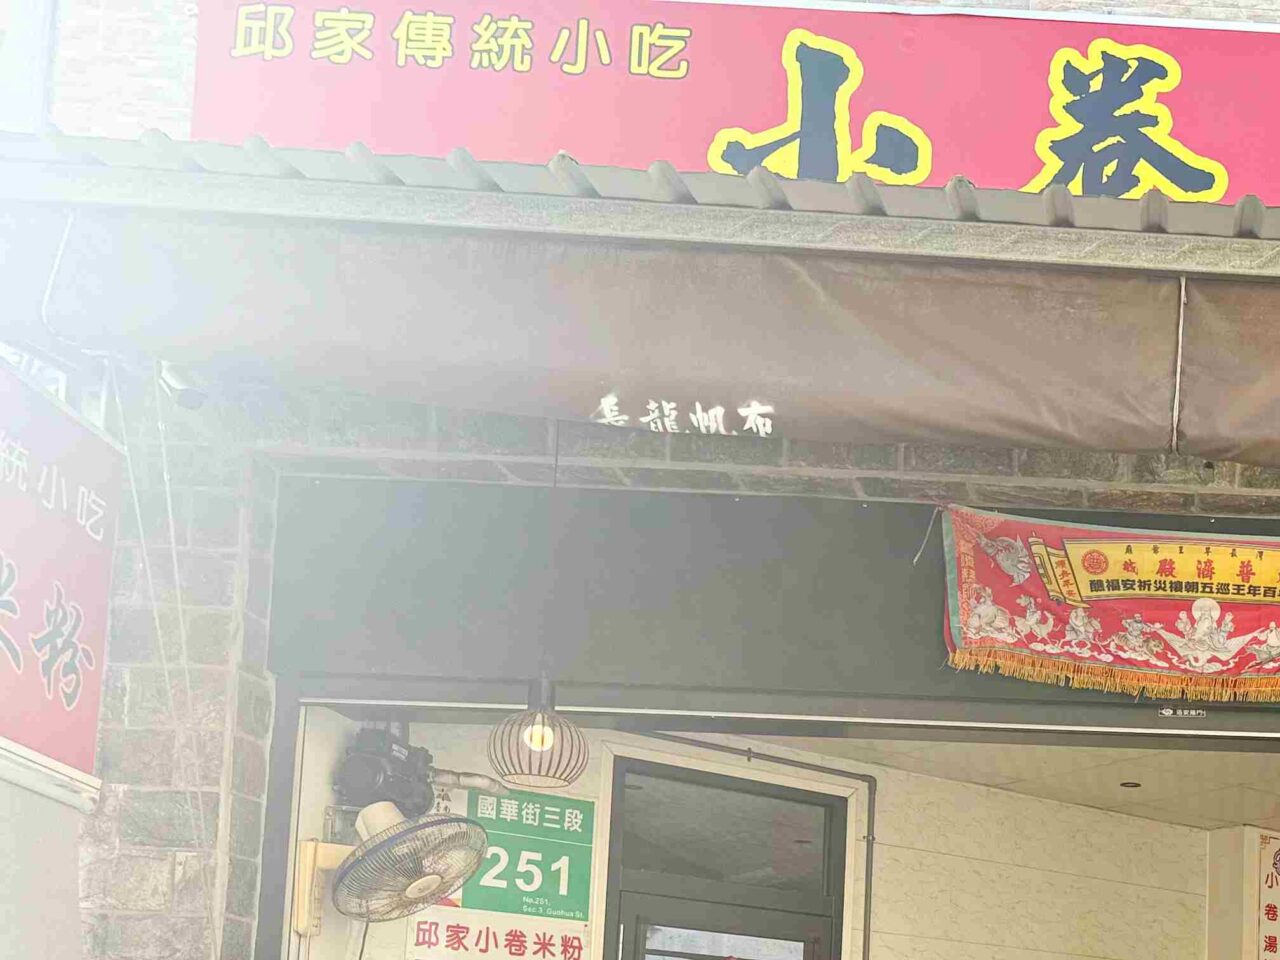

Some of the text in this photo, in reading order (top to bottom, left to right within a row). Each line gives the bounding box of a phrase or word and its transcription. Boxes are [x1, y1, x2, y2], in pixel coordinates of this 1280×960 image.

[229, 2, 693, 80] 邱家傳統小吃
[477, 795, 583, 834] 國華街三段
[478, 846, 571, 896] 251
